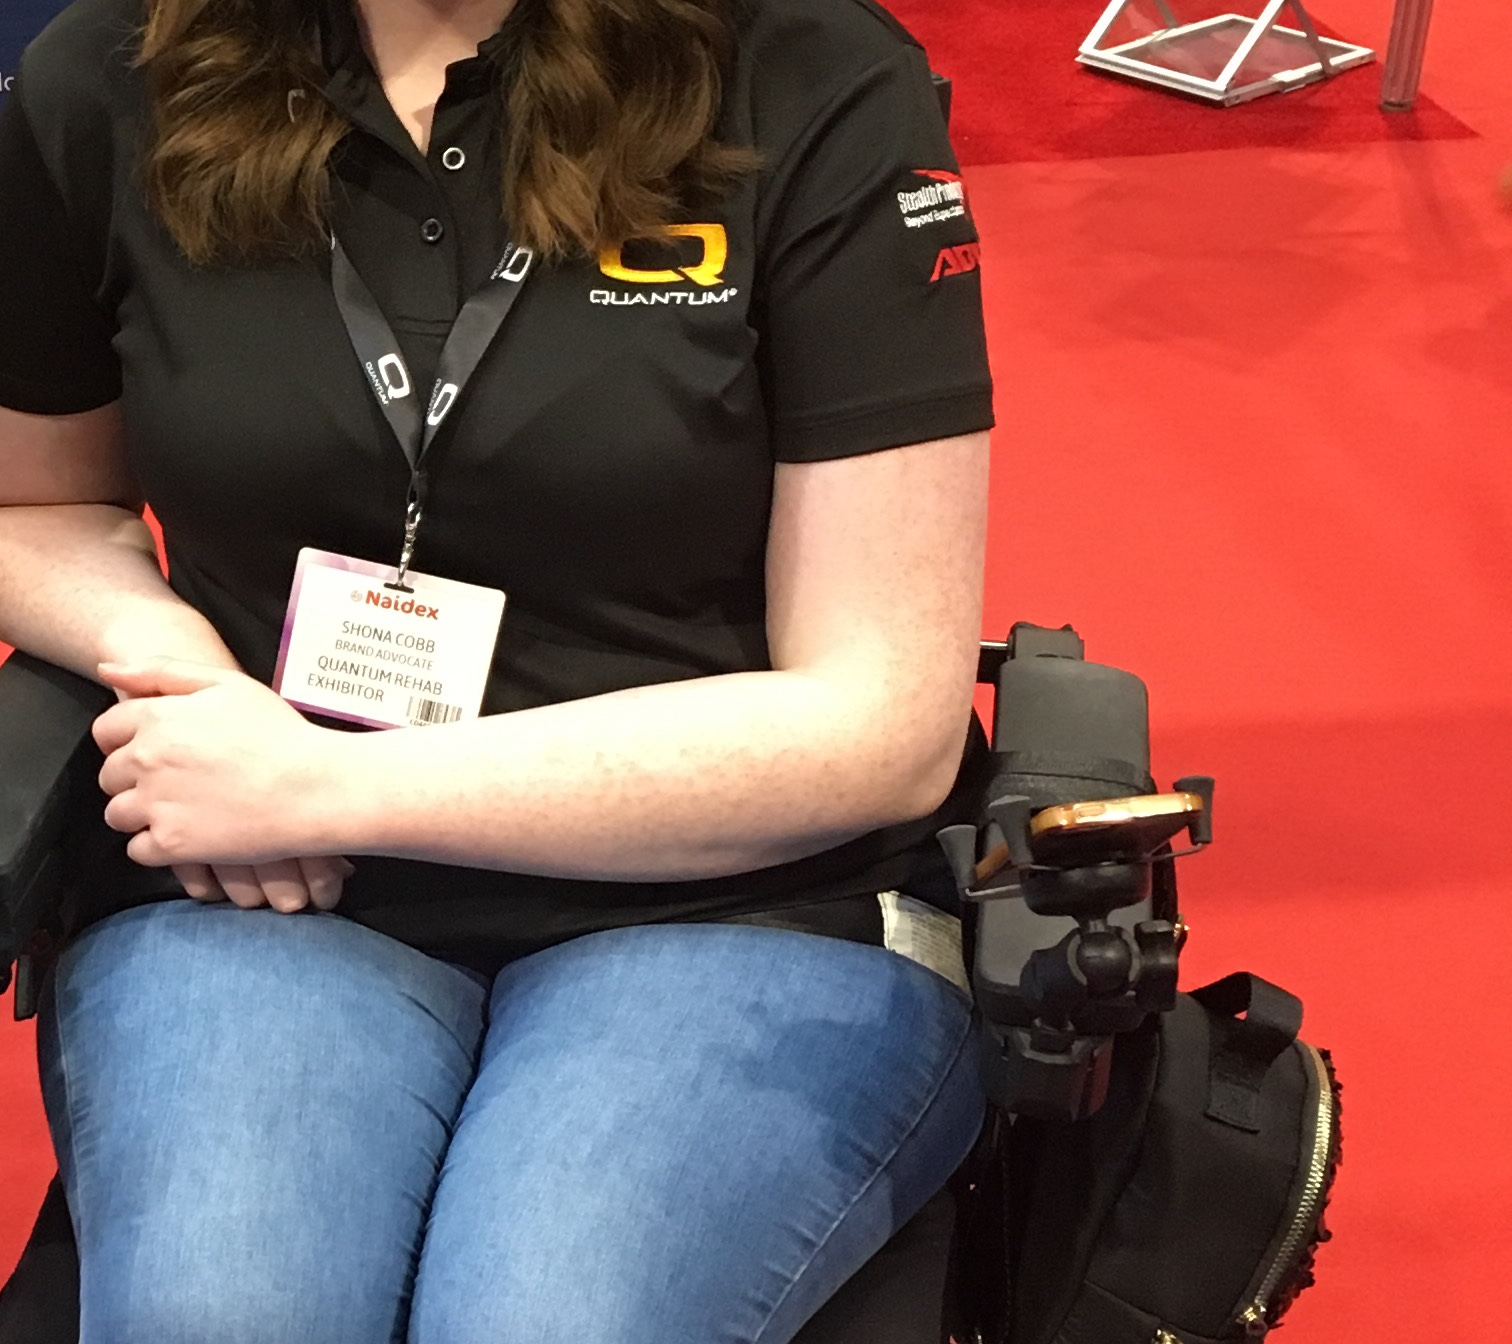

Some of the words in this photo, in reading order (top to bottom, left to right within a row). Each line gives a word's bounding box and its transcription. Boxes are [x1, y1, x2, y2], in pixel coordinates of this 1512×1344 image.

[365, 590, 439, 620] Naidex
[342, 621, 392, 644] SHONA
[395, 633, 436, 654] COBB
[335, 639, 374, 658] BRAND
[375, 649, 433, 671] ADVOCATE
[307, 673, 385, 703] EXHIBITOR
[317, 655, 392, 684] QUANTUM
[394, 673, 443, 696] REHAB
